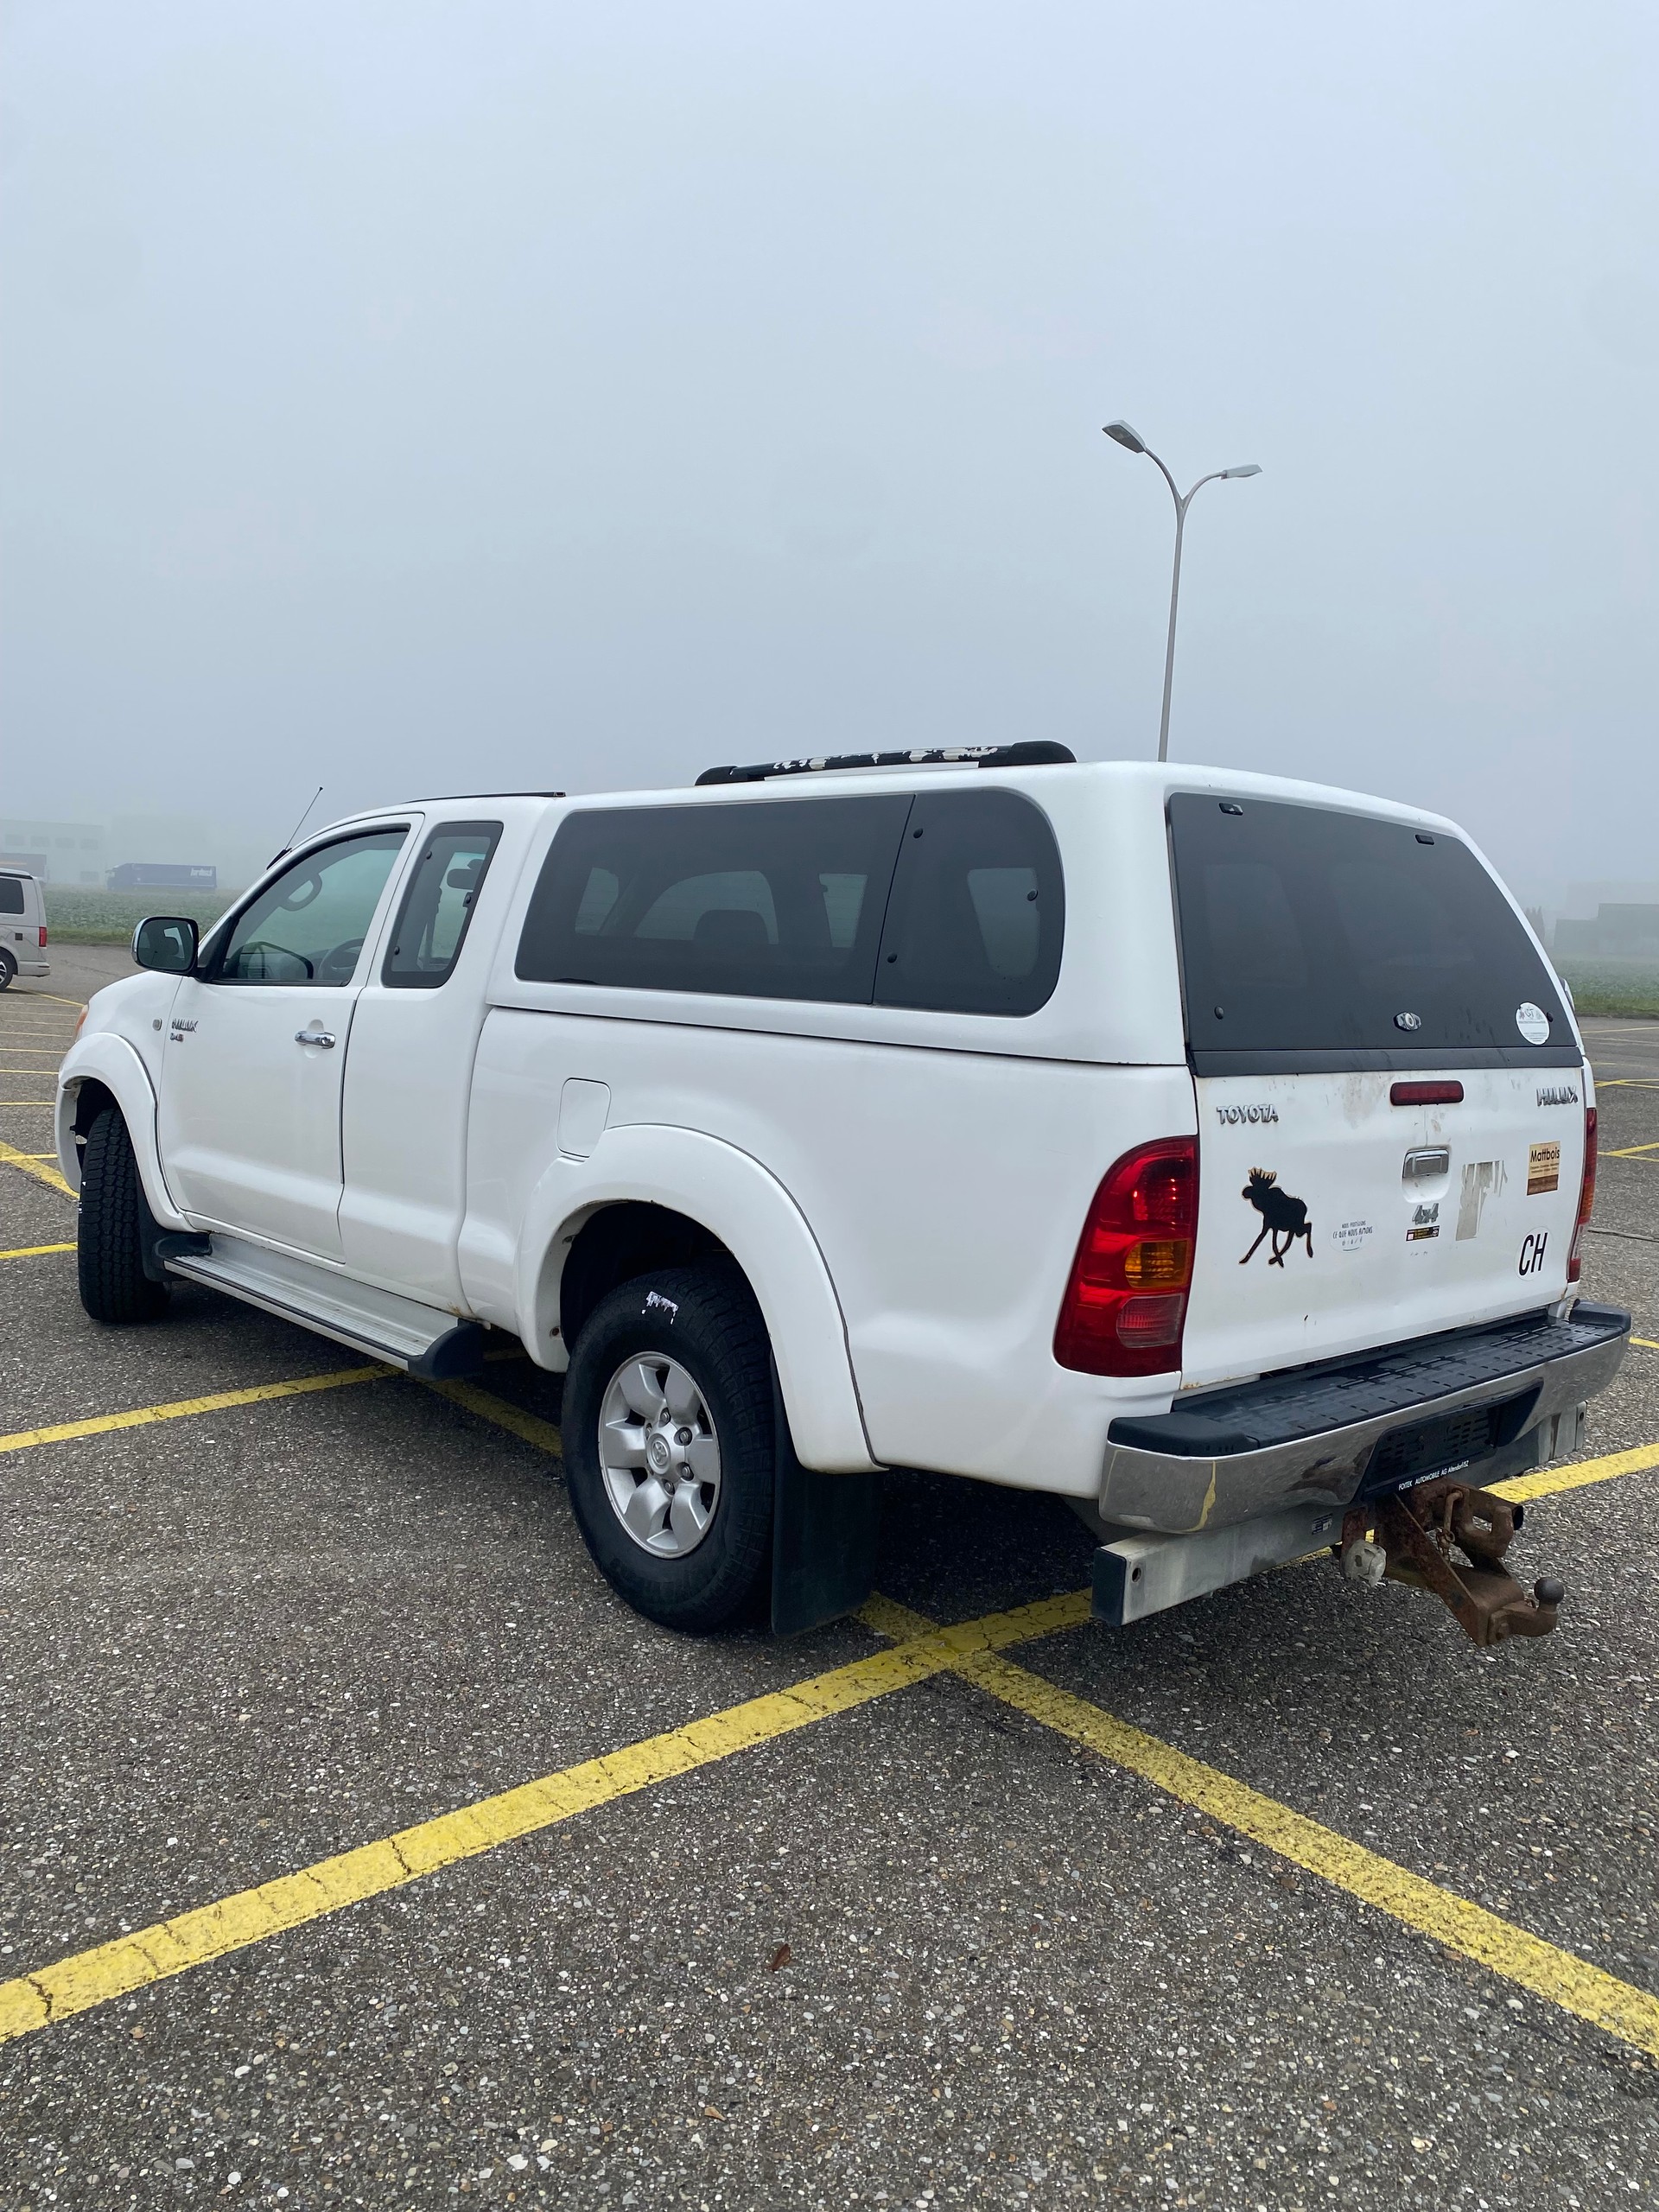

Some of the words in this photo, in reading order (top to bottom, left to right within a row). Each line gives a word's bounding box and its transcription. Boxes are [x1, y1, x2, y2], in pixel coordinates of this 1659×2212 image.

[1535, 1085, 1579, 1107] HILUX
[1216, 1104, 1279, 1125] TOYOTA
[1530, 1147, 1560, 1163] Mattbois
[1411, 1202, 1440, 1225] 4x4
[1518, 1232, 1548, 1276] CH
[1415, 1471, 1440, 1485] AUTOMOBILE
[1440, 1468, 1447, 1477] AG
